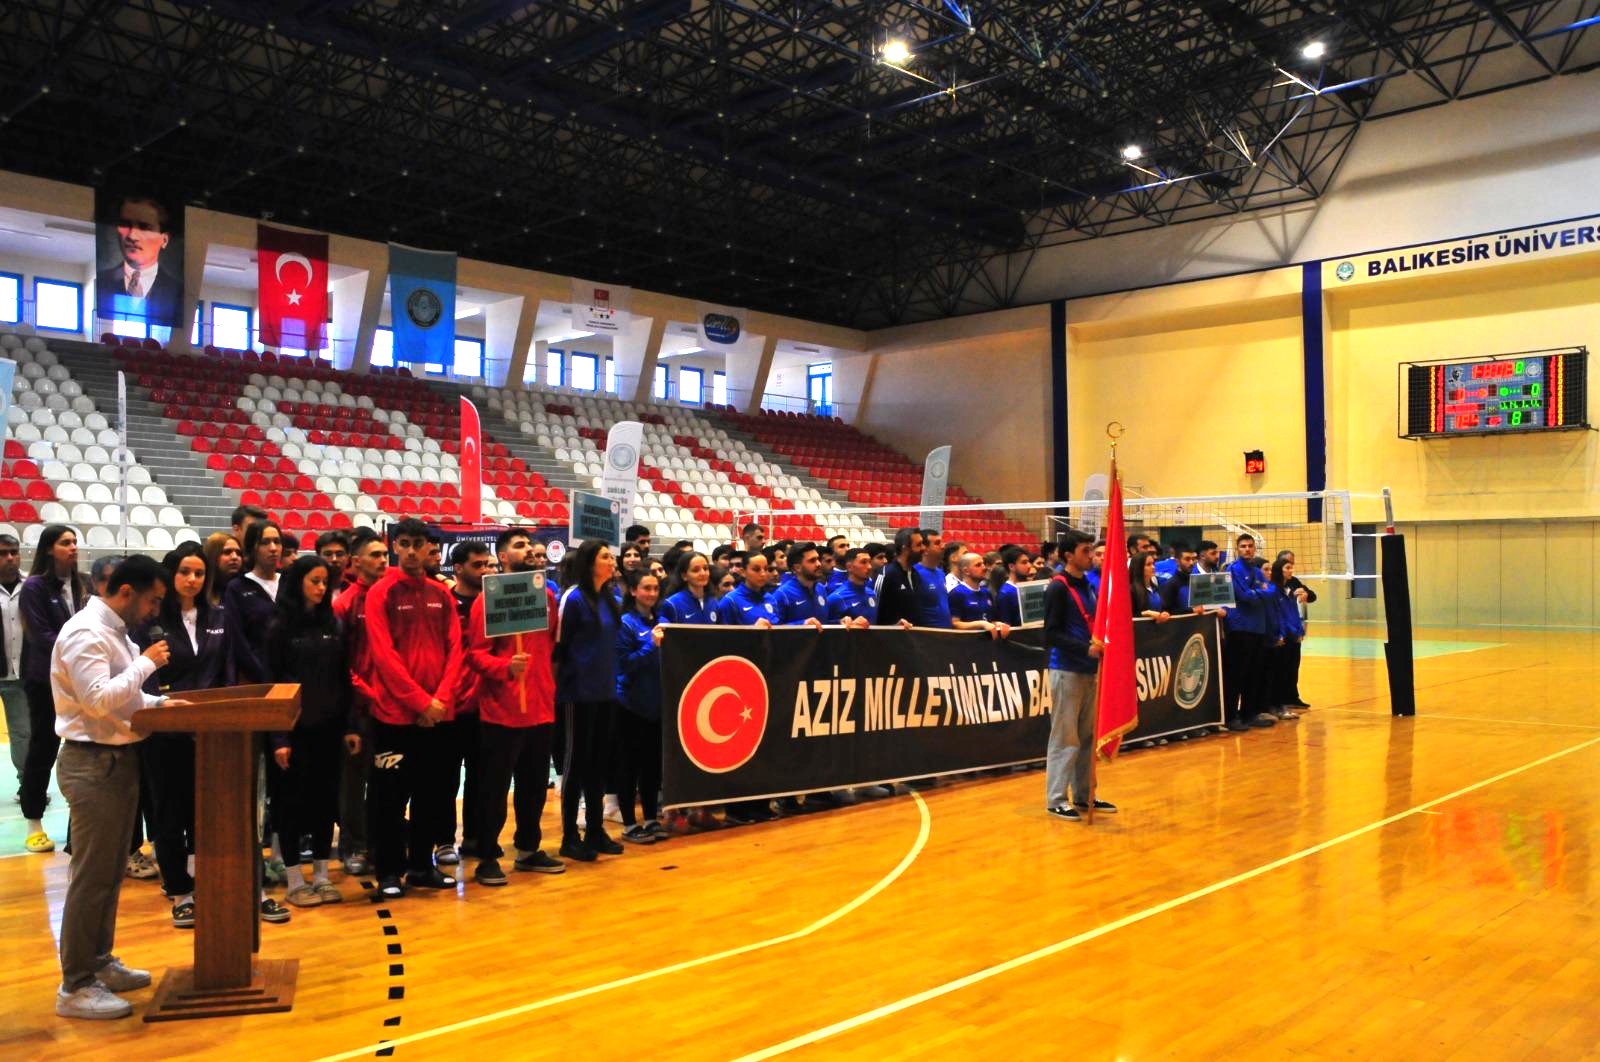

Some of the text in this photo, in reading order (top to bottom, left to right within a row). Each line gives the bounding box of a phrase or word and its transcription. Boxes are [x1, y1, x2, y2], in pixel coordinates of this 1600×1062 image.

[1368, 225, 1600, 276] BALIKESİR ÜNİVER
[1247, 460, 1263, 472] 24
[791, 664, 857, 738] AZİZ
[864, 661, 1024, 732] MİLLETİMİZİN
